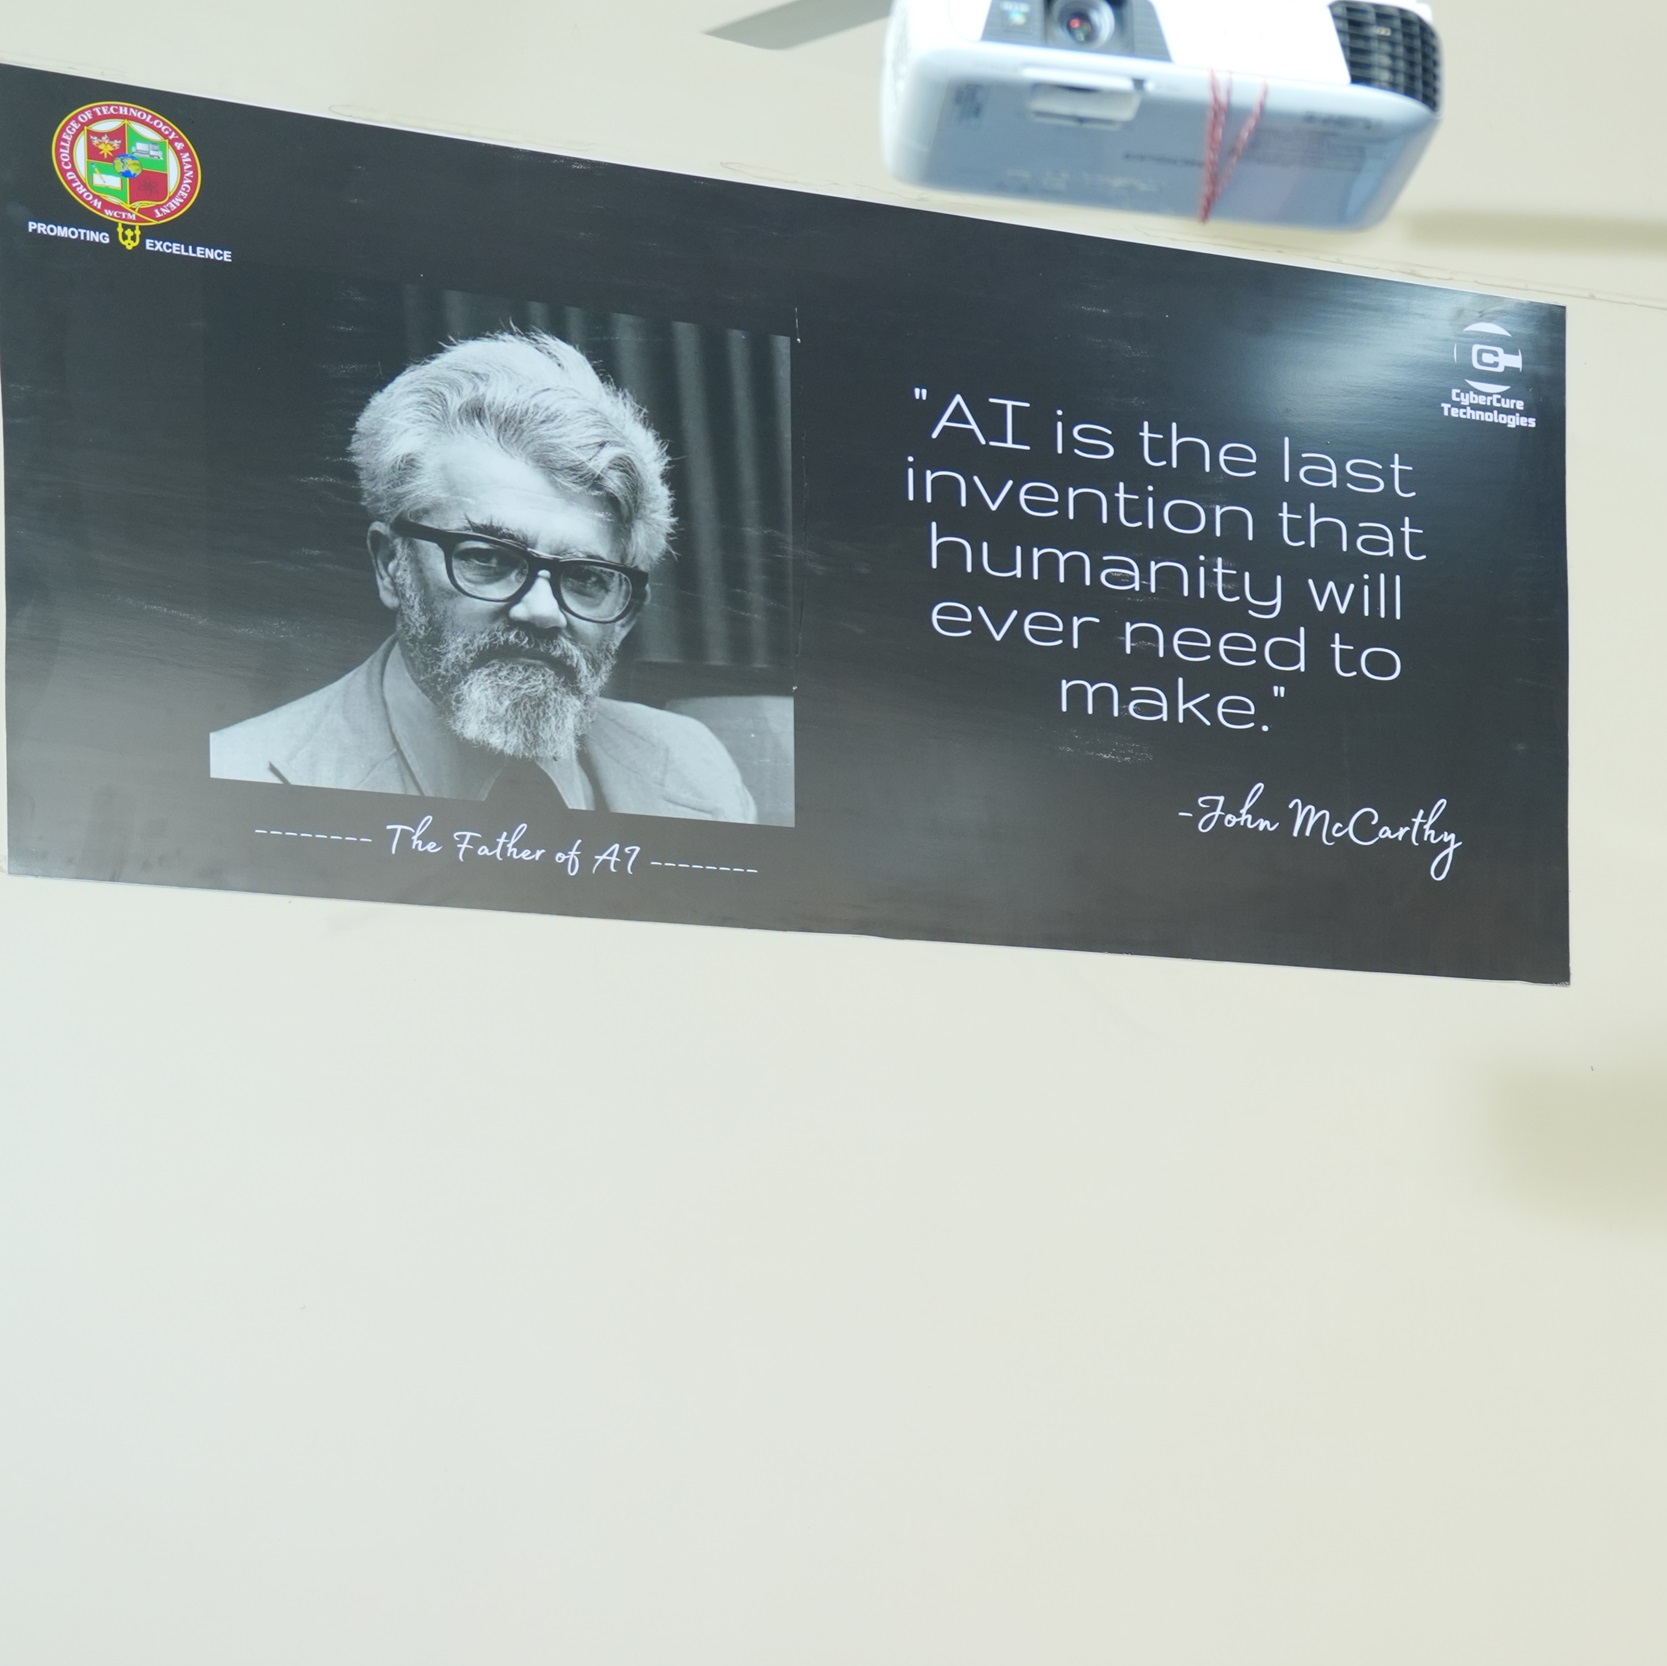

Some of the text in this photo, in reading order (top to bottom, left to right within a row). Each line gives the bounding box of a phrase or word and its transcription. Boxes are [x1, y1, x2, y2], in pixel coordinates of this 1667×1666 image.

[60, 105, 195, 218] WORLD COLLEGE OF TECHNOLOGY & MANAGEMENT
[28, 220, 233, 263] PROMOTING EXCELLENCE
[104, 208, 137, 221] WCTM
[1441, 403, 1536, 428] Technologies
[1451, 388, 1524, 410] CyberCure
[913, 387, 1417, 498] "AI is the last
[906, 456, 1427, 561] invention that
[930, 521, 1402, 620] humanity will
[930, 601, 1402, 682] ever need to
[1060, 677, 1287, 733] make."
[385, 815, 641, 876] The Father of AI
[1288, 798, 1463, 881] McCarthy
